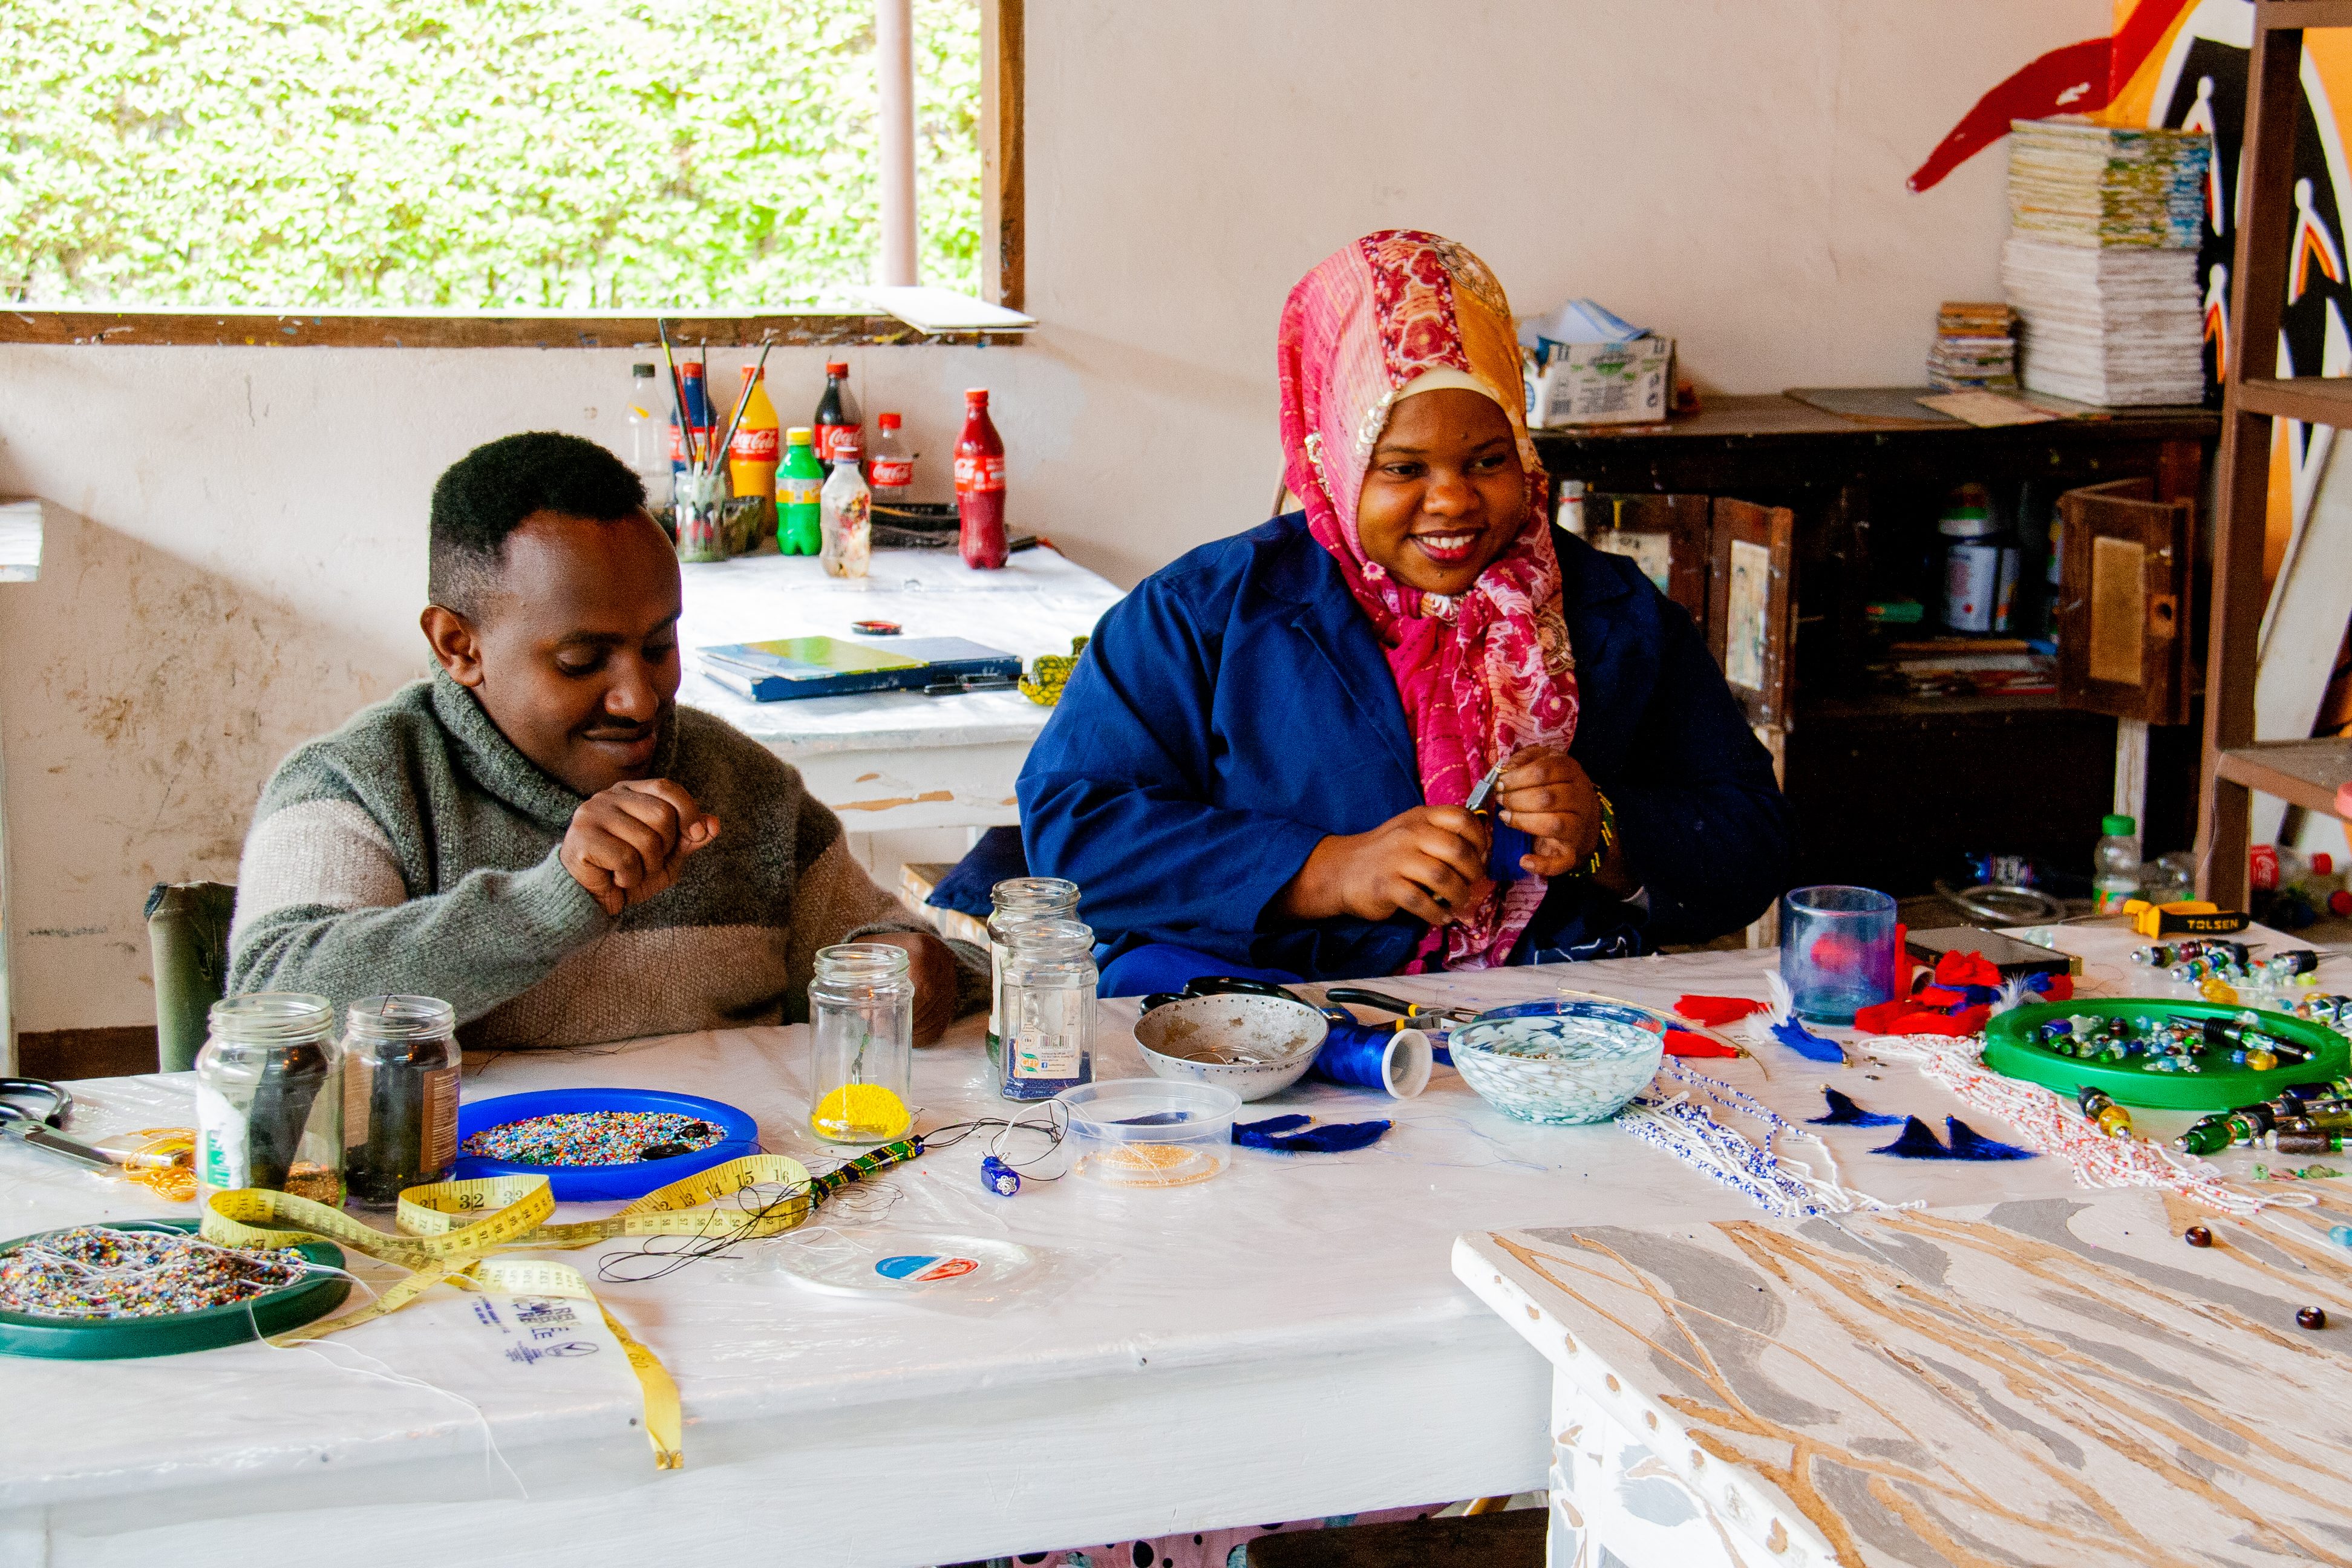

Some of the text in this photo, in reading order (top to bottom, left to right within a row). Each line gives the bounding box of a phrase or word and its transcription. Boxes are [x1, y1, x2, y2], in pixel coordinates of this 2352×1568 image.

[2187, 919, 2239, 930] TOLSEN
[1021, 1059, 1039, 1067] GFP
[679, 1193, 696, 1207] 13
[705, 1182, 724, 1200] 14
[735, 1171, 754, 1189] 15
[774, 1169, 789, 1184] 16
[459, 1193, 485, 1209] 32
[503, 1190, 524, 1206] 33
[443, 1241, 454, 1250] 99
[462, 1236, 472, 1246] 98
[479, 1230, 489, 1240] 97
[495, 1223, 505, 1234] 96
[509, 1215, 519, 1227] 95
[522, 1209, 532, 1219] 94
[697, 1218, 706, 1226] 56
[714, 1218, 724, 1227] 55
[766, 1217, 774, 1226] 52
[493, 1269, 503, 1283] 134
[523, 1269, 533, 1284] 136
[540, 1270, 549, 1284] 137
[555, 1271, 563, 1285] 138
